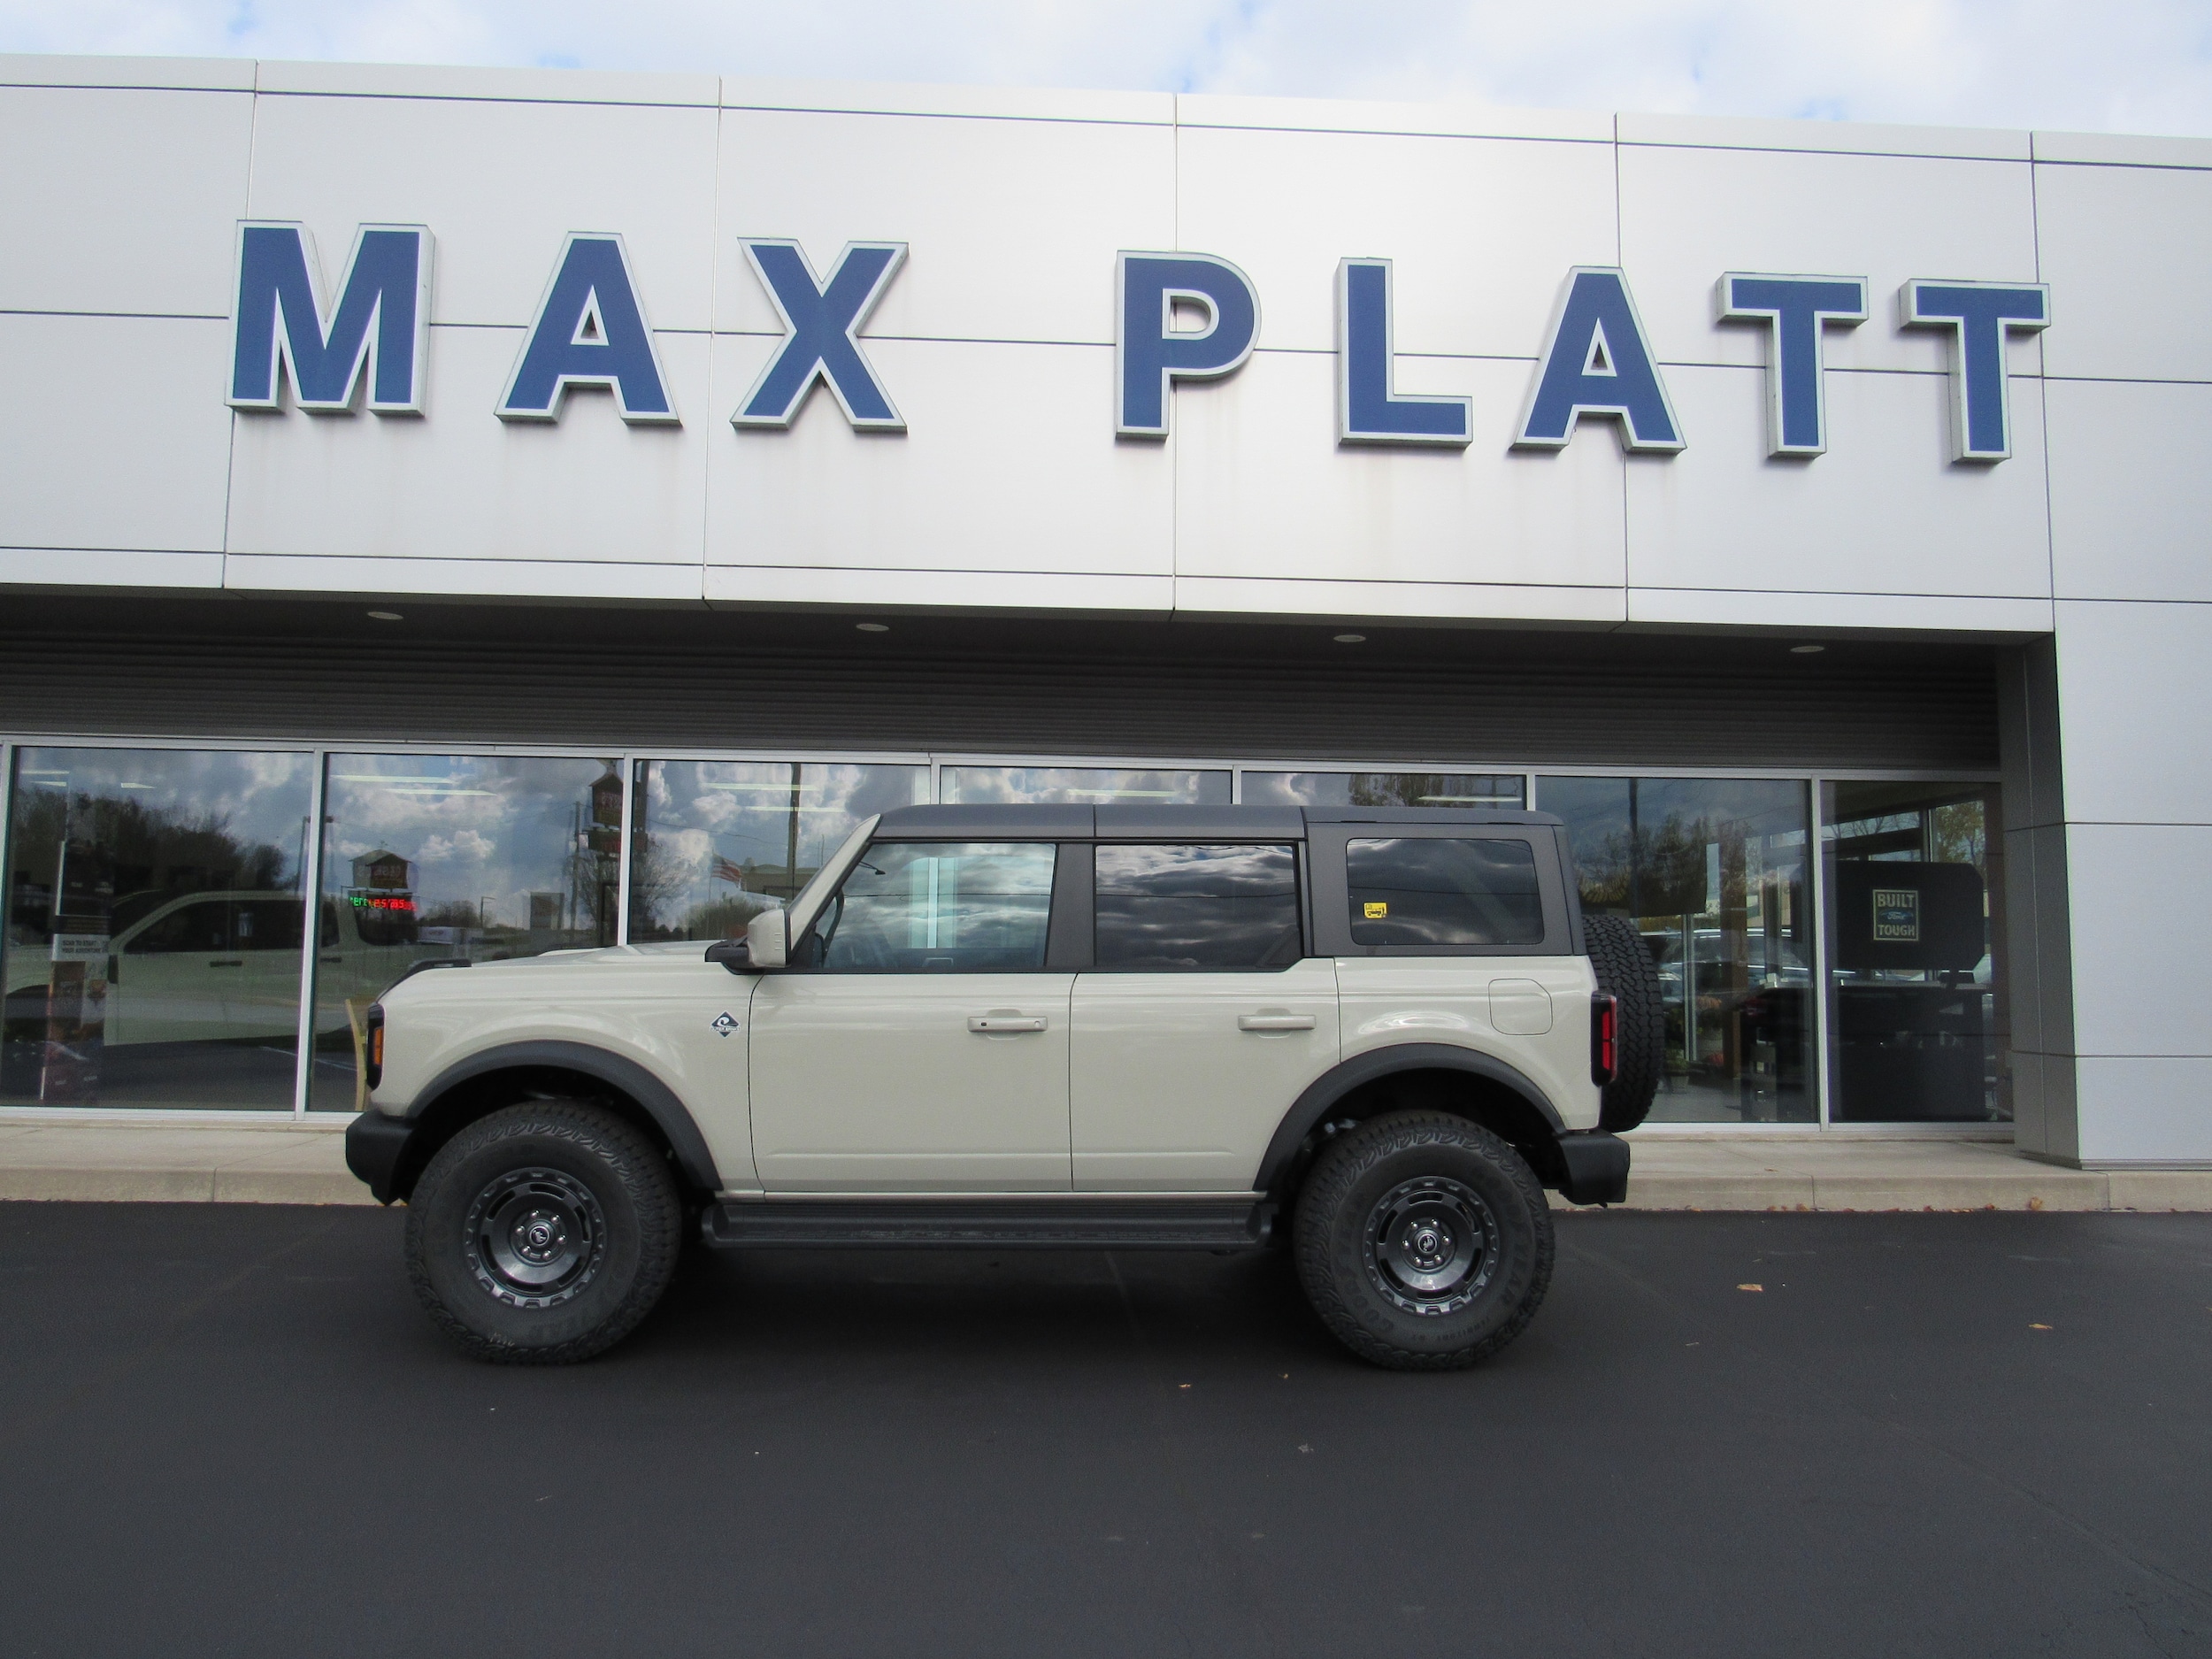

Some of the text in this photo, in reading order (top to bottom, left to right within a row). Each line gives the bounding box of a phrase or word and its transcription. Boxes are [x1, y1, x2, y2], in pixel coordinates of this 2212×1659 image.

[227, 221, 2050, 462] MAX PLATT
[1877, 893, 1915, 908] BUILT
[1877, 924, 1916, 937] TOUGH
